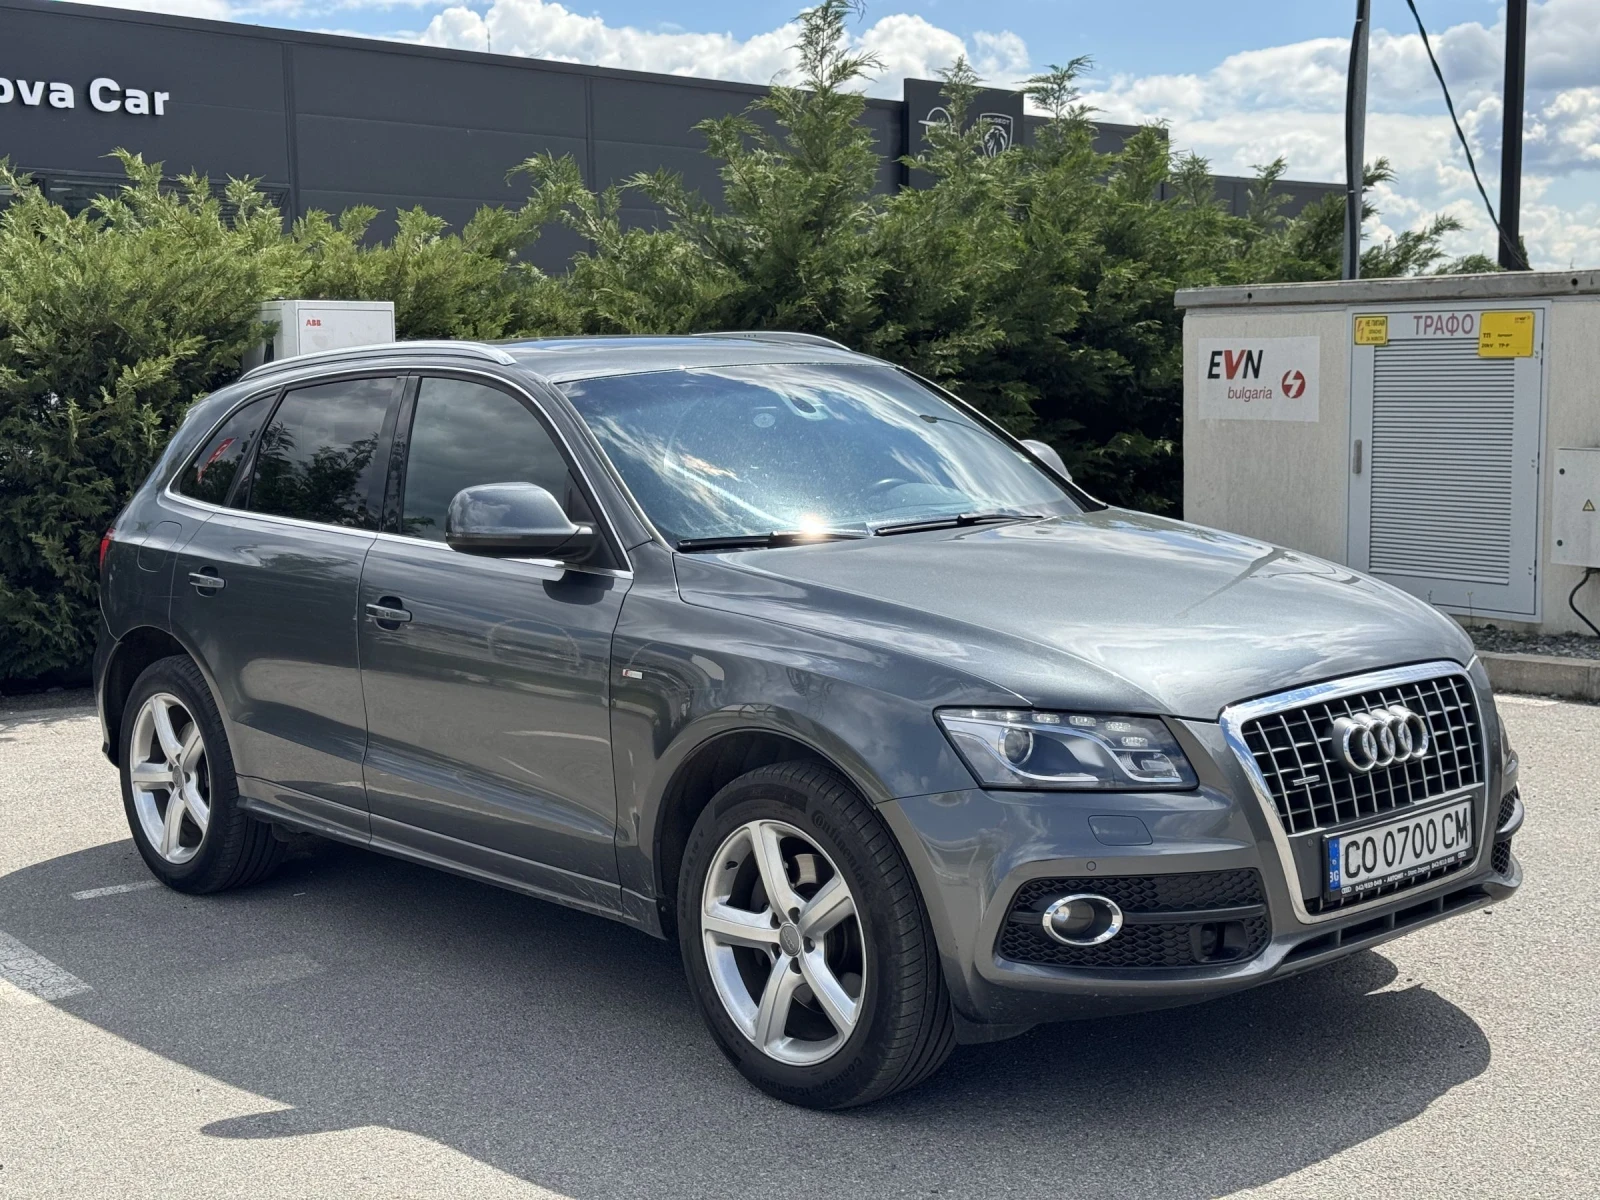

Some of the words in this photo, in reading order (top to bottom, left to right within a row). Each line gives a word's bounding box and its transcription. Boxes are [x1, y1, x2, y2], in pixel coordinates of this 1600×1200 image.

[89, 77, 169, 115] Car
[1413, 312, 1474, 336] ТРАФО
[1207, 349, 1263, 380] EVN
[1228, 386, 1273, 402] bulgaria
[1345, 836, 1377, 878] CO
[1383, 818, 1437, 867] 0700
[1442, 808, 1468, 849] CM
